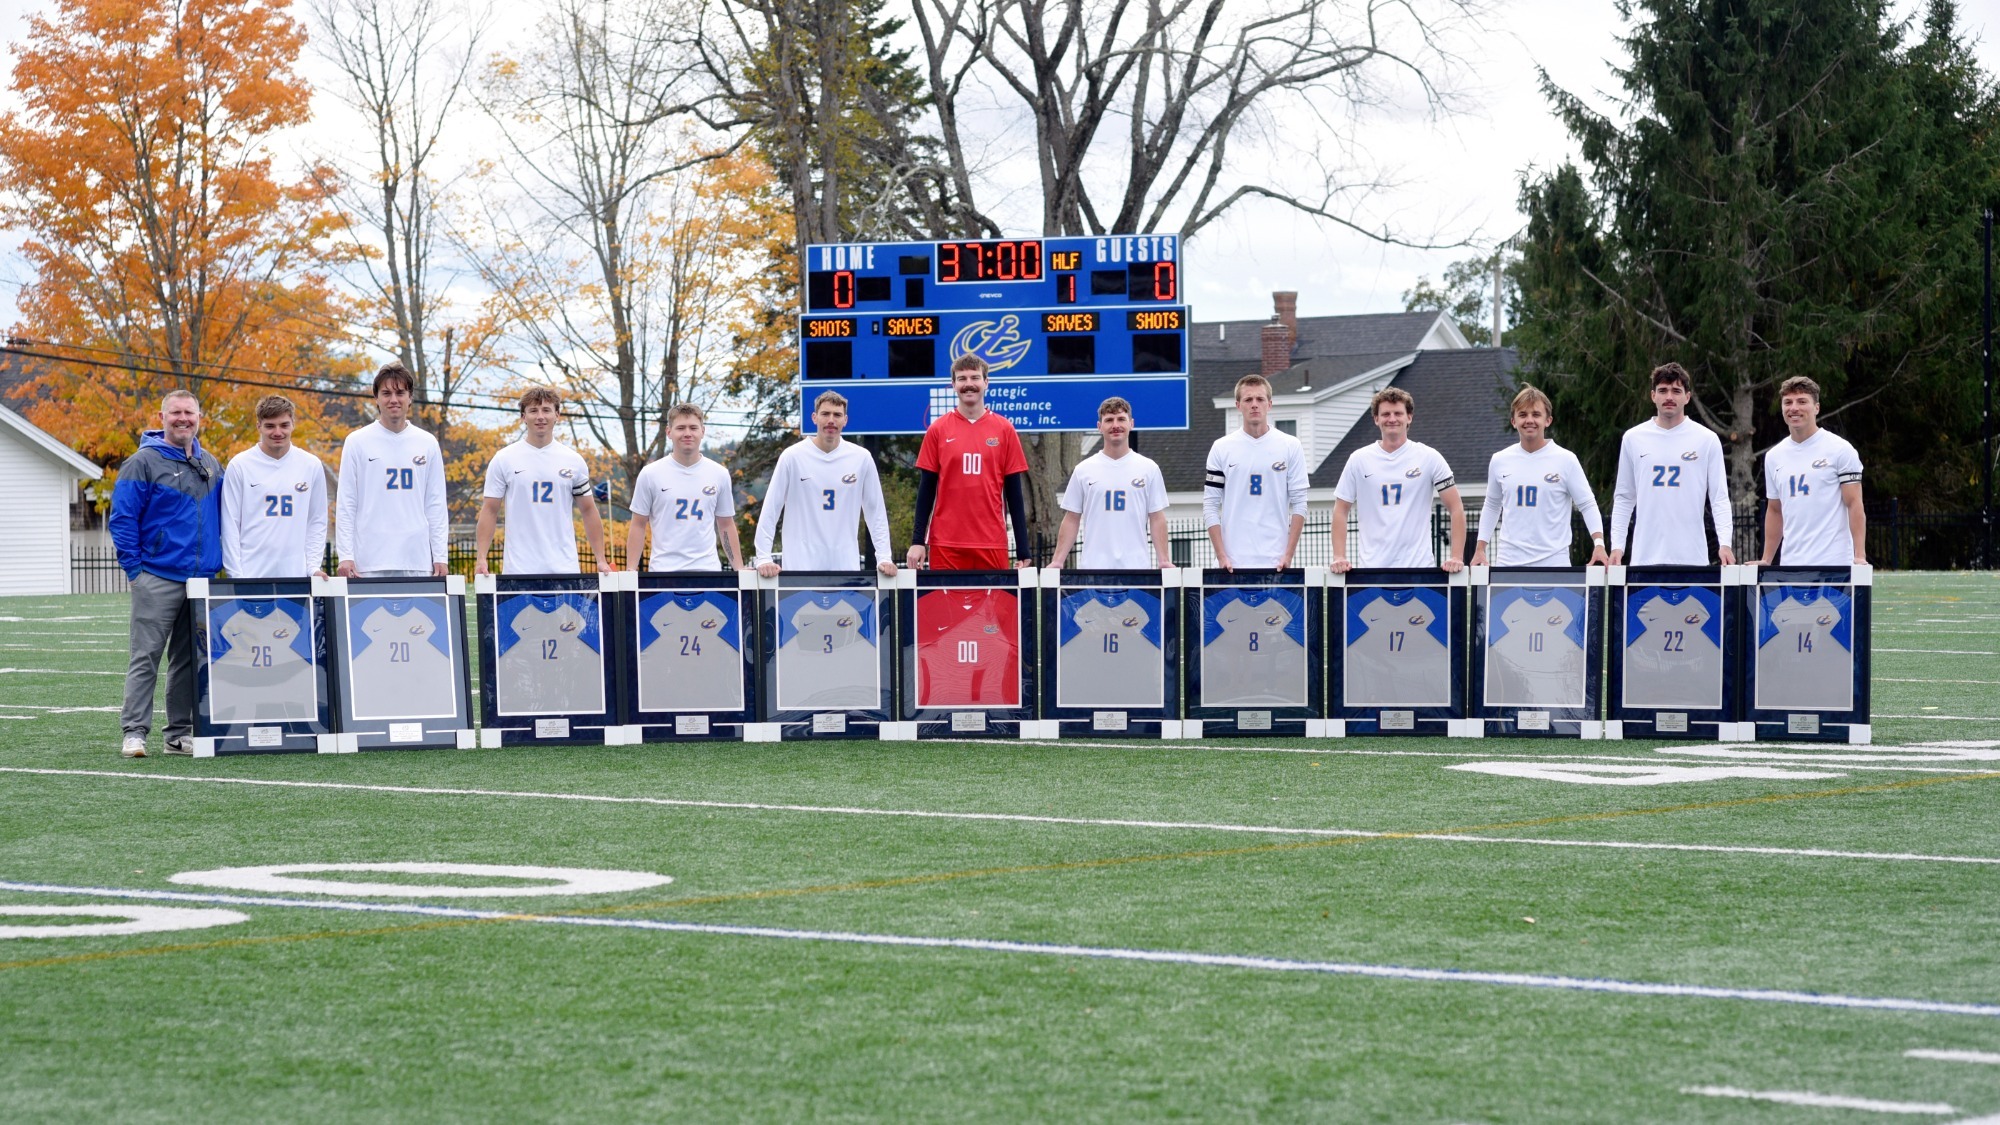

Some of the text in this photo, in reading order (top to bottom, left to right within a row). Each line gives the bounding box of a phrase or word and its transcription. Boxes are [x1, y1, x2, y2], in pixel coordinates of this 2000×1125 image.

[822, 246, 874, 270] HOME
[1096, 237, 1172, 262] GUESTS
[942, 241, 1040, 281] 37:00
[1052, 252, 1079, 270] HLF
[834, 271, 853, 308] 0
[1069, 275, 1075, 302] 1
[1154, 262, 1175, 300] 0
[809, 320, 850, 337] SHOTS
[888, 318, 932, 335] SAVES
[1047, 314, 1093, 331] SAVES
[1136, 312, 1179, 330] SHOTS
[984, 386, 1027, 400] rategic
[984, 401, 1052, 411] aintenance
[1038, 414, 1061, 425] inc.
[962, 452, 982, 475] 00
[386, 467, 414, 490] 20
[1249, 473, 1263, 496] 8
[1652, 465, 1681, 488] 22
[1789, 473, 1810, 498] 14
[532, 481, 554, 504] 12
[822, 489, 836, 511] 3
[1104, 489, 1126, 512] 16
[1381, 483, 1403, 507] 17
[1516, 484, 1538, 507] 10
[265, 494, 293, 517] 26
[675, 498, 704, 521] 24
[389, 641, 410, 663] 20
[541, 639, 558, 660] 12
[679, 635, 702, 656] 24
[823, 634, 833, 654] 3
[957, 640, 978, 663] 00
[1103, 633, 1119, 654] 16
[1248, 632, 1259, 652] 8
[1389, 631, 1405, 652] 17
[1528, 632, 1544, 653] 10
[1663, 630, 1684, 652] 22
[1797, 632, 1813, 654] 14
[251, 645, 273, 668] 26
